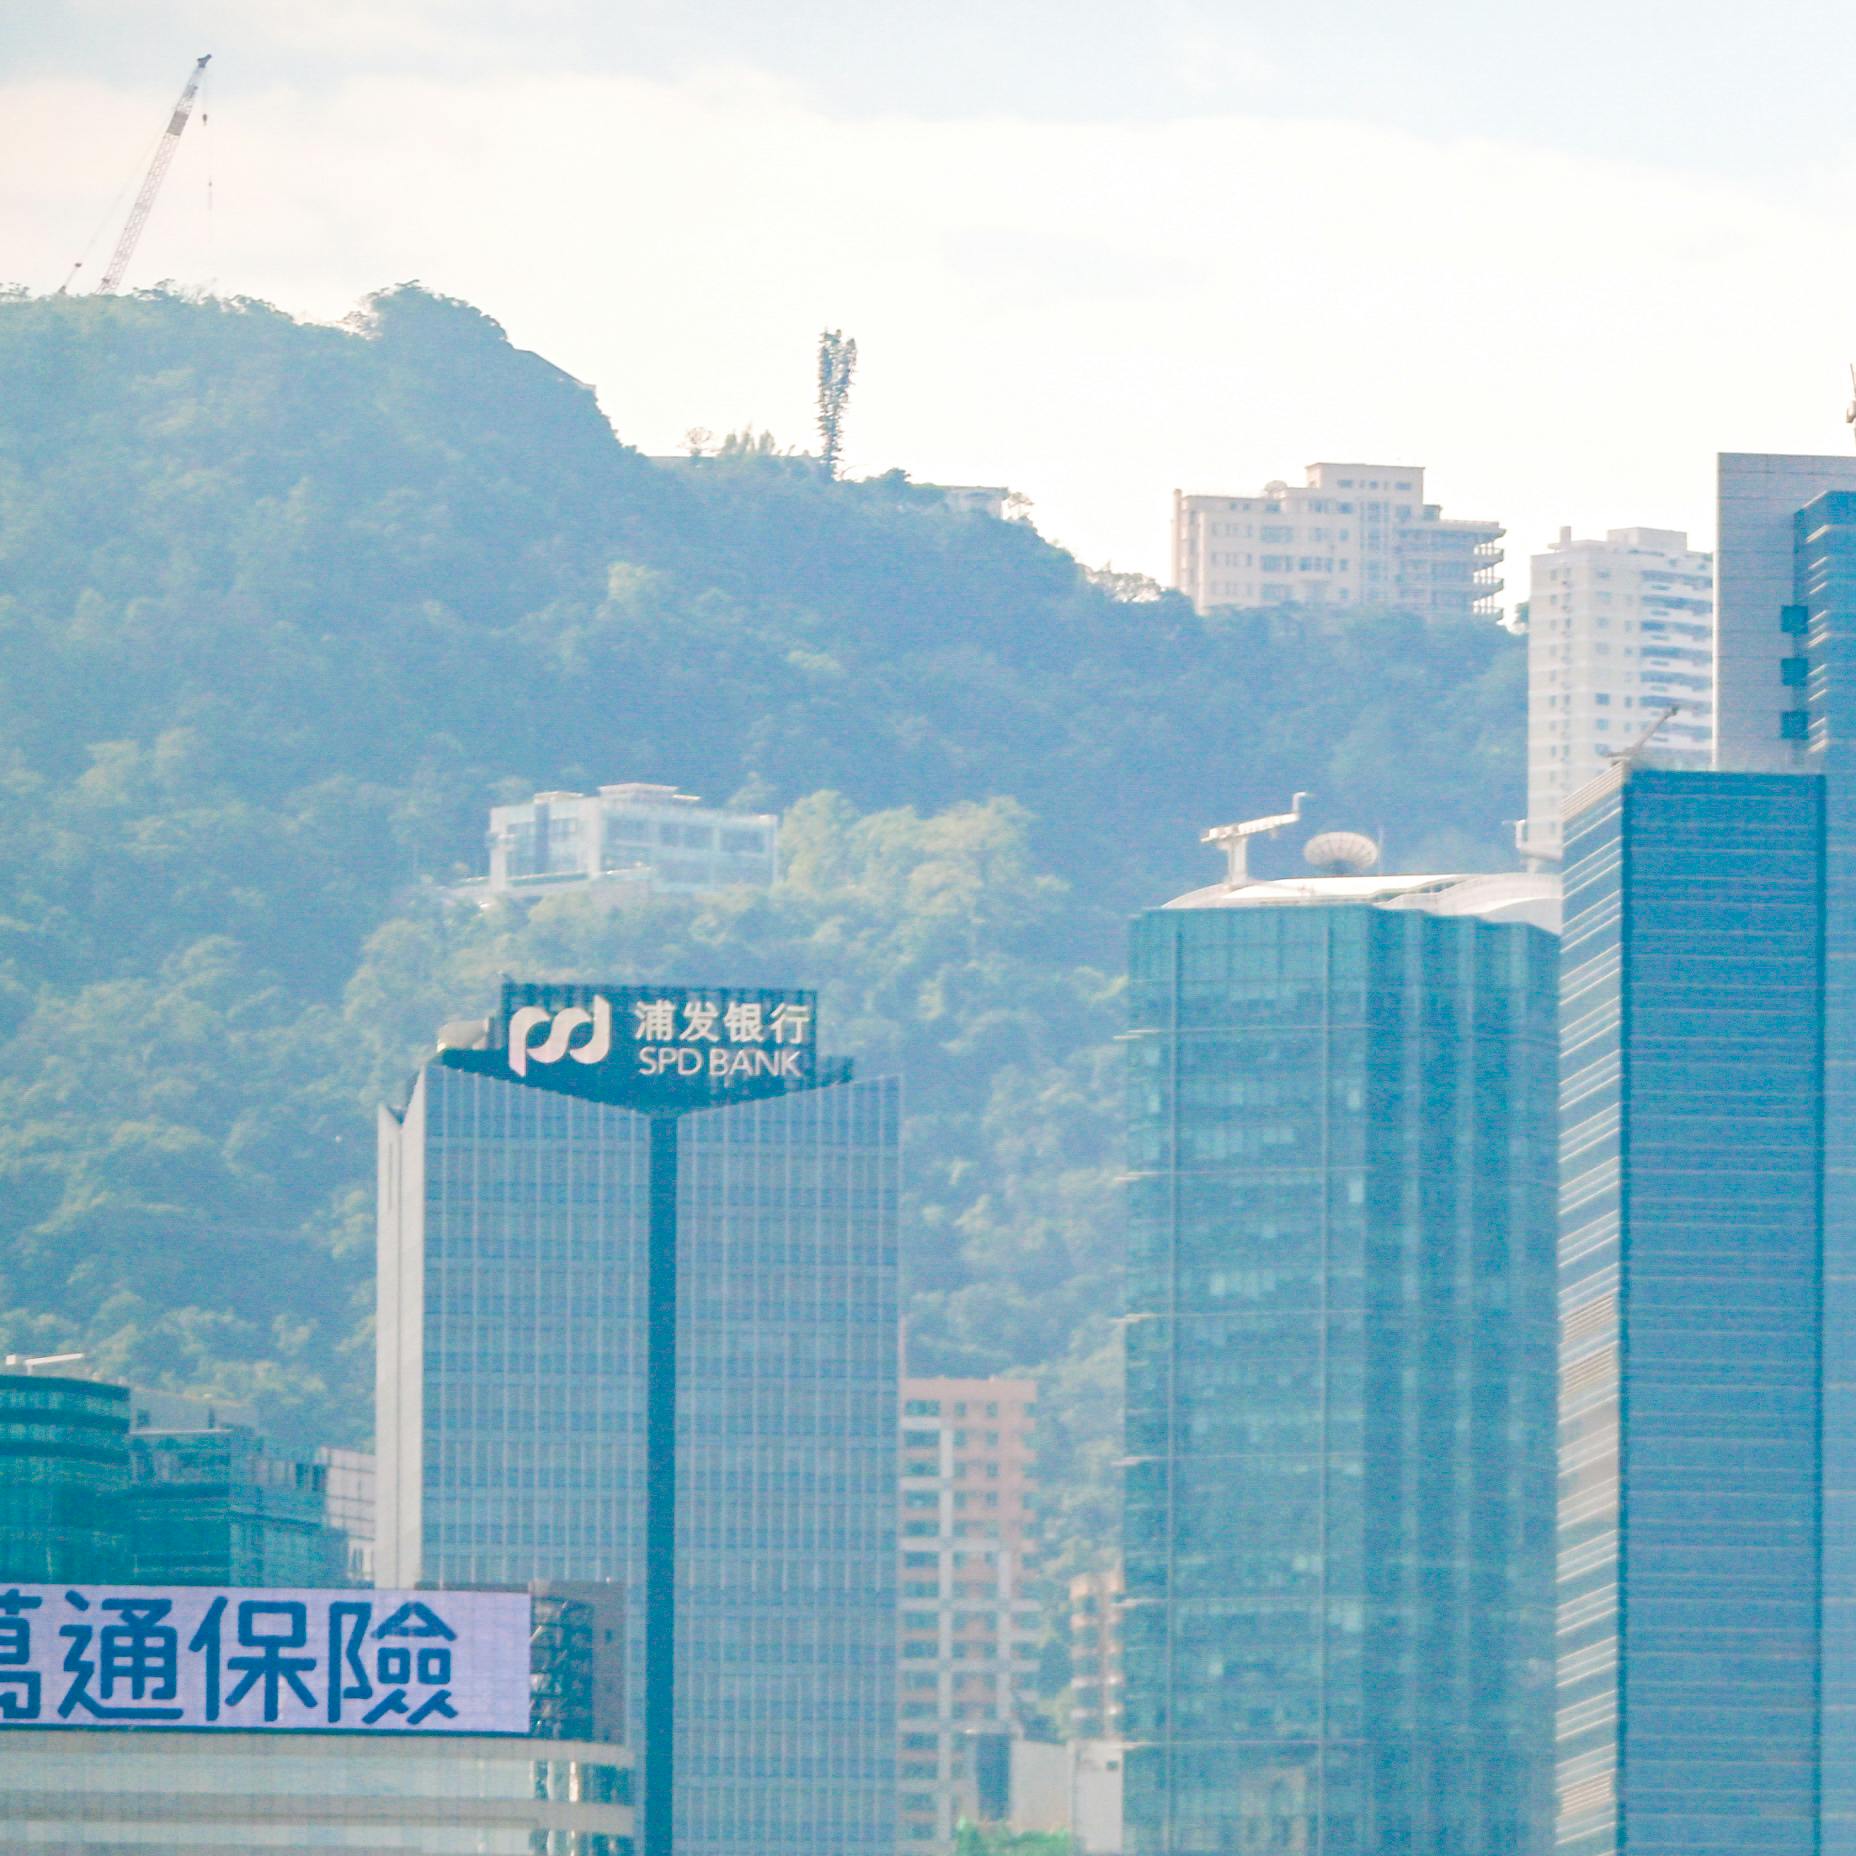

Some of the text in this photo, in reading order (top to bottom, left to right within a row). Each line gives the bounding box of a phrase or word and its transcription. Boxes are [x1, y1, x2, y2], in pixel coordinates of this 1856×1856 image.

[634, 998, 811, 1045] 浦发银行
[638, 1046, 802, 1078] SPD BANK
